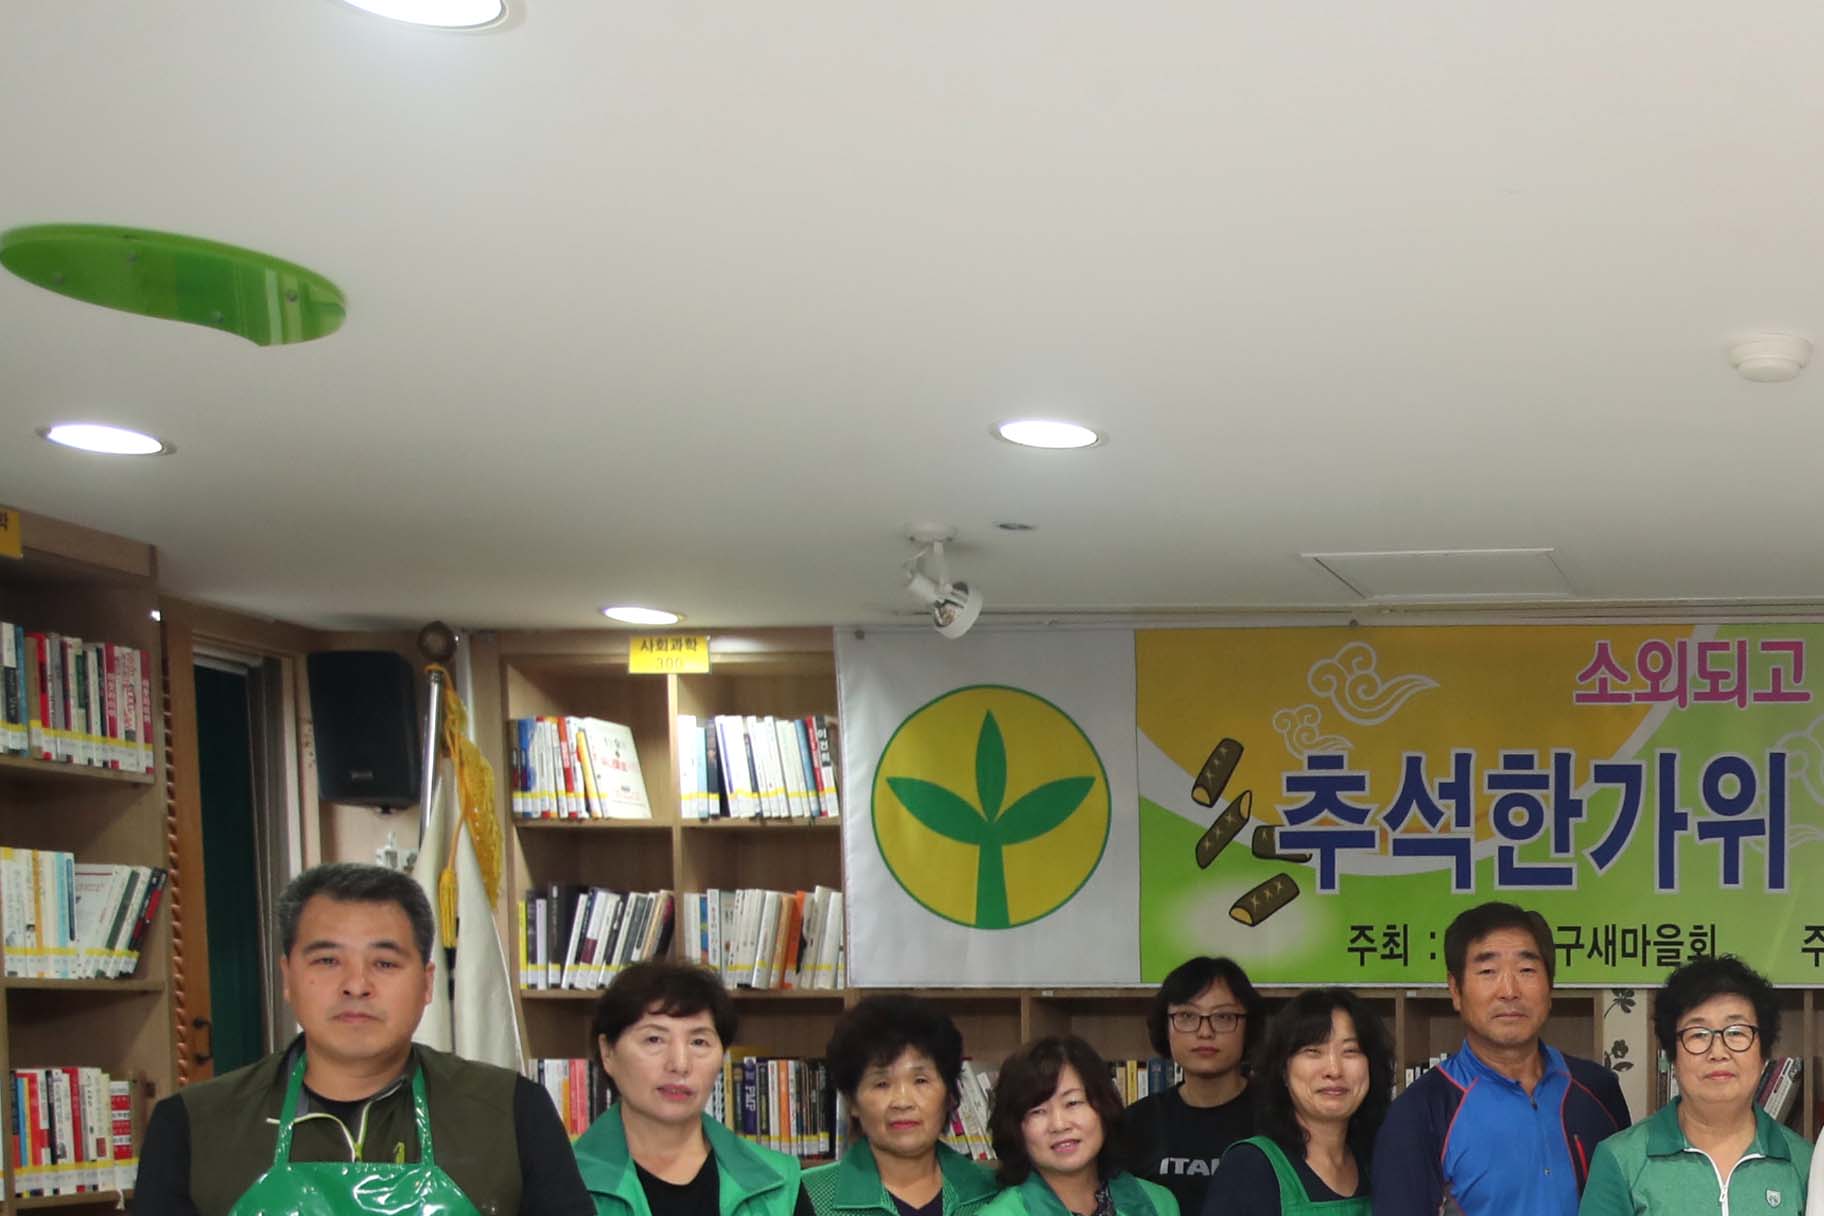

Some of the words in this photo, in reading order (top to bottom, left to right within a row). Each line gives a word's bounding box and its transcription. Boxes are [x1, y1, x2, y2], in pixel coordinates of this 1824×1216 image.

[640, 636, 697, 653] 사회과학
[1574, 640, 1811, 709] 소외되고
[1279, 749, 1787, 889] 추석한가위
[1347, 923, 1409, 967] 주최
[1554, 922, 1719, 968] 구새마을회
